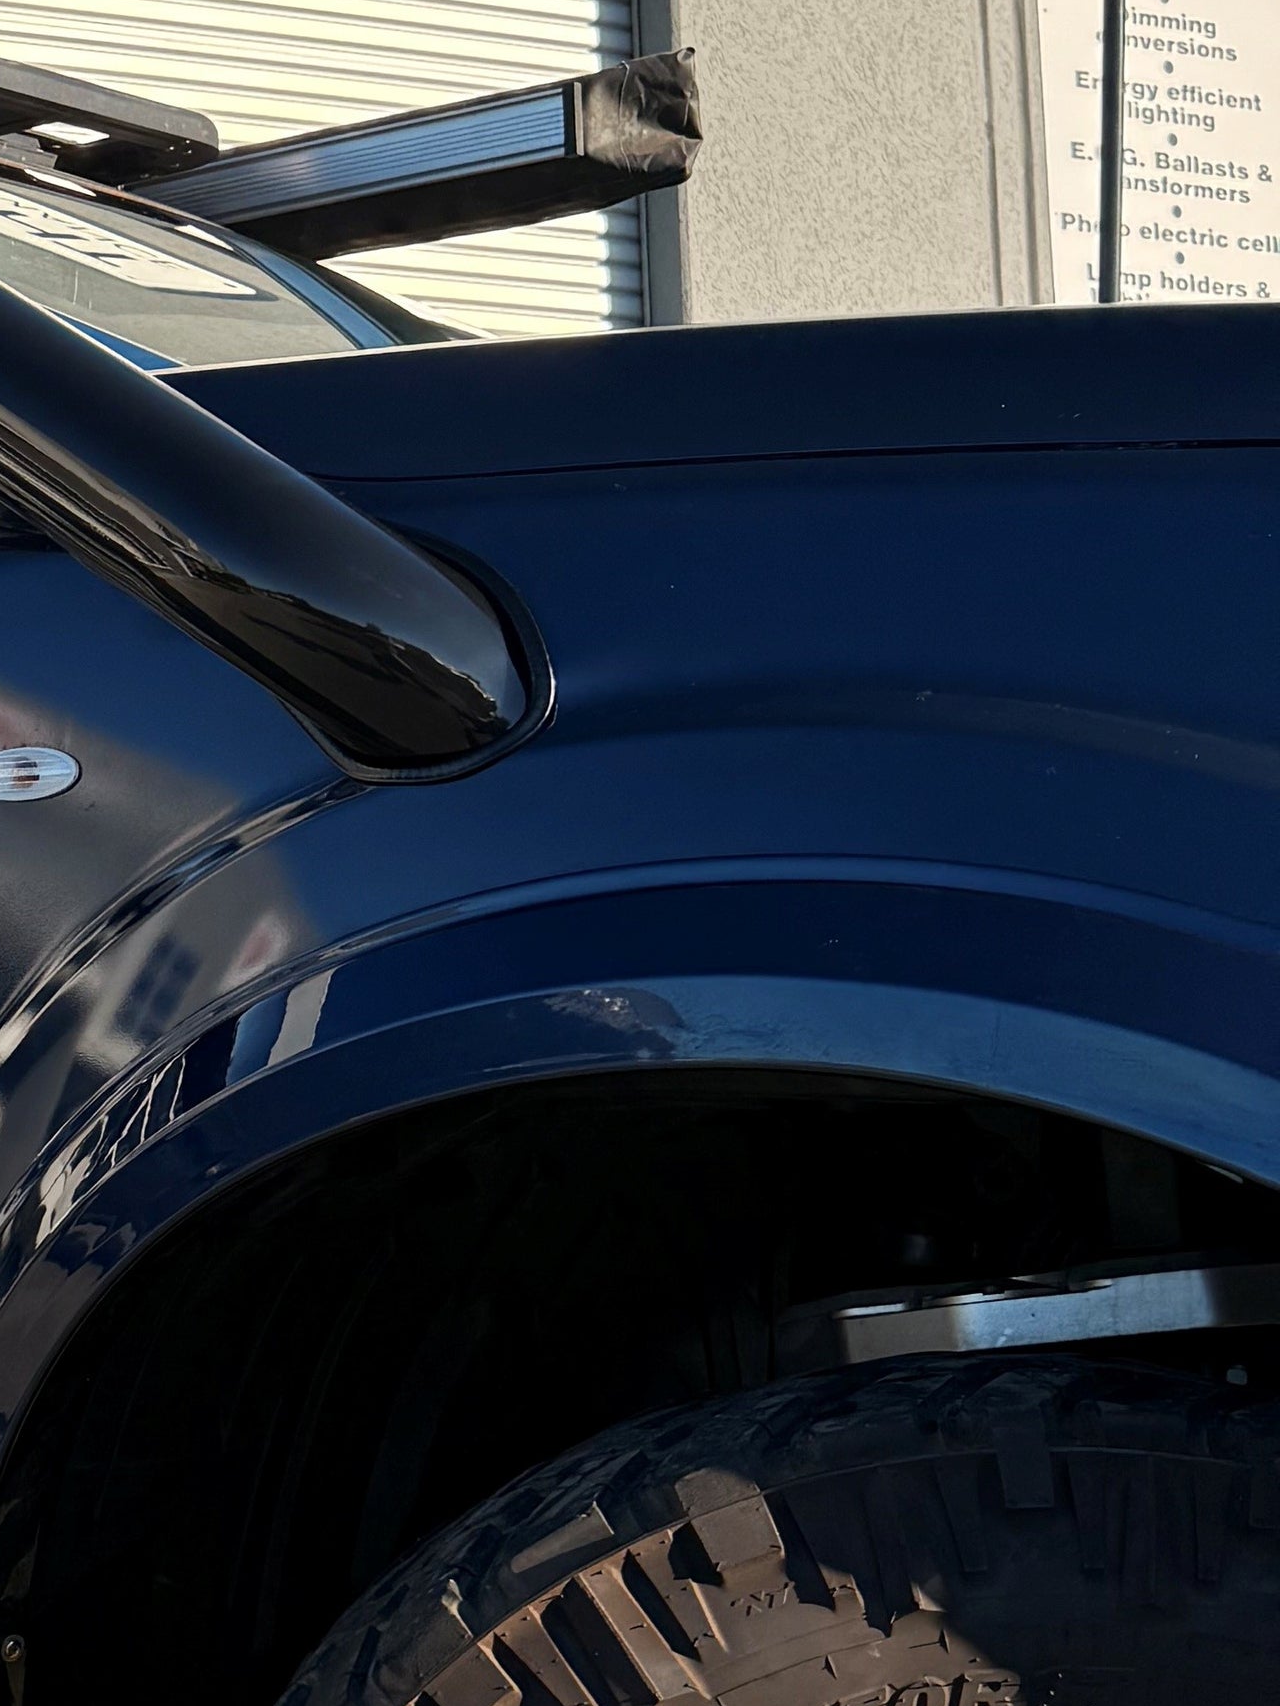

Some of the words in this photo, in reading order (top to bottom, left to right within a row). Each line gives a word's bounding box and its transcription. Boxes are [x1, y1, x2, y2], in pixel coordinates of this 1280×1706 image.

[1124, 6, 1217, 39] imming
[1167, 84, 1263, 112] efficient
[1127, 100, 1216, 133] lighting
[1154, 151, 1250, 180] Ballasts
[1257, 164, 1273, 183] &
[1121, 176, 1251, 204] ansformers
[1060, 212, 1131, 237] Pho
[1139, 223, 1229, 248] electric
[1086, 262, 1152, 291] Lmp
[1159, 271, 1248, 298] holders
[1255, 281, 1271, 299] &
